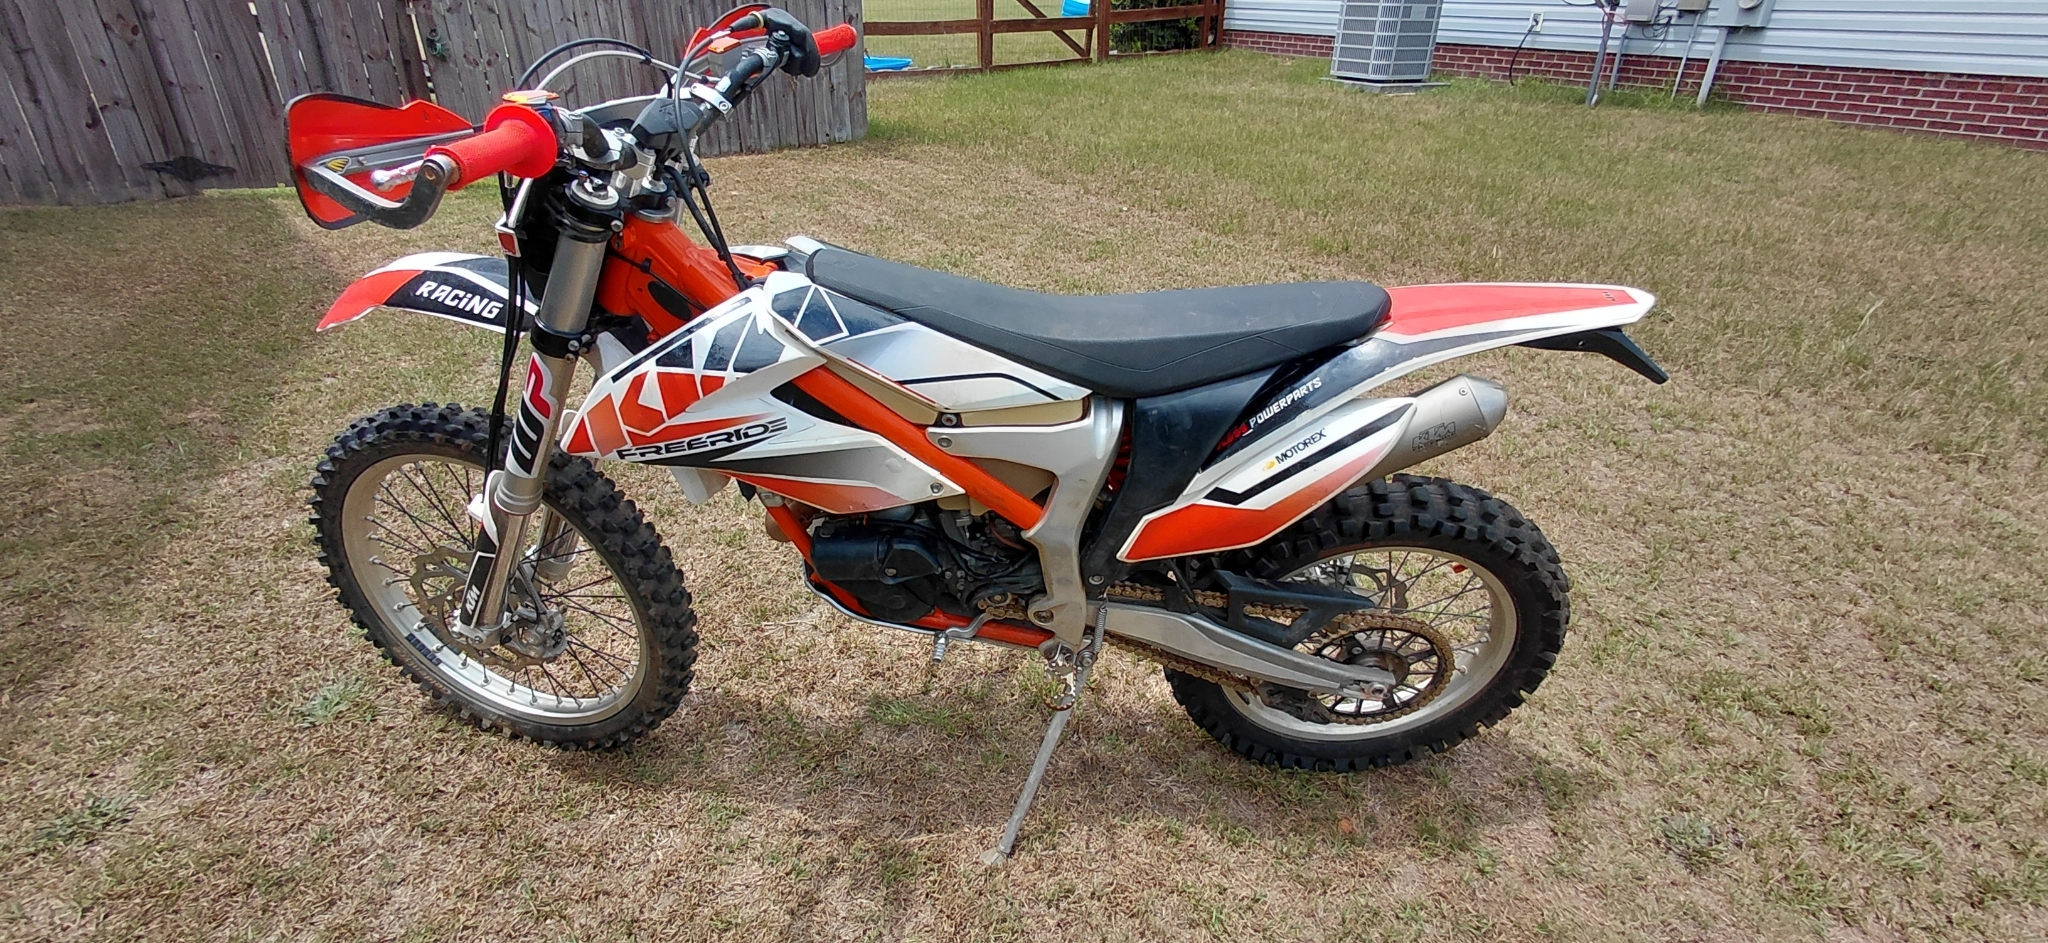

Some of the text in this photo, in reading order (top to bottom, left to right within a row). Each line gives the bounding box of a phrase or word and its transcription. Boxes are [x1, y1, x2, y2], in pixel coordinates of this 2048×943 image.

[1248, 376, 1322, 429] POWERPARTS
[616, 416, 788, 460] FREERIDE
[1275, 428, 1327, 464] MOTOREX
[1412, 421, 1456, 449] KTM
[465, 584, 481, 615] KTM
